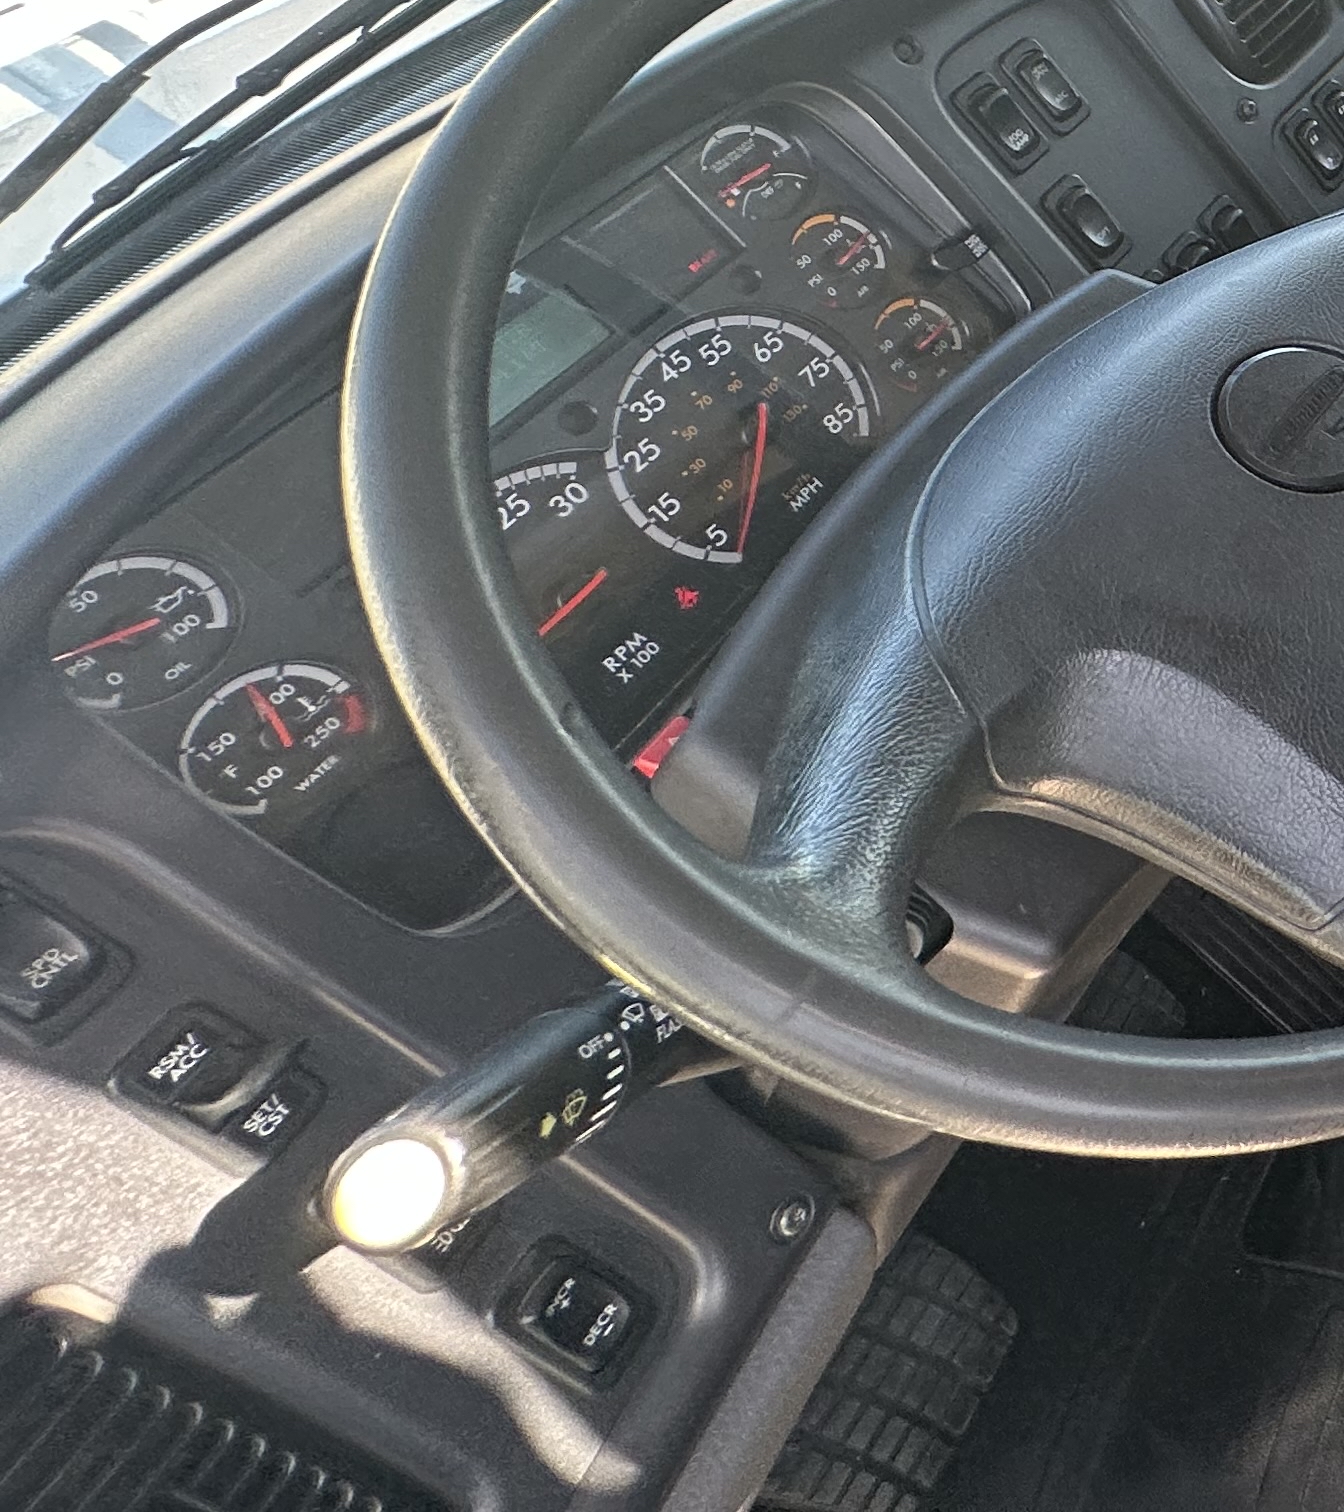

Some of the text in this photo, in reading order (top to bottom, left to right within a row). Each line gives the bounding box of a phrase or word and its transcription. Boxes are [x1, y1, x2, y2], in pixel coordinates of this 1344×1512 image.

[822, 228, 843, 246] 100
[796, 254, 811, 269] 50
[850, 257, 871, 275] 150
[827, 286, 838, 297] 0
[903, 312, 922, 329] 100
[698, 334, 732, 366] 55
[754, 331, 784, 363] 65
[879, 339, 894, 354] 50
[661, 349, 692, 382] 45
[797, 356, 830, 388] 75
[907, 370, 917, 380] 0
[727, 379, 743, 394] 90
[629, 389, 666, 423] 35
[694, 395, 713, 410] 70
[822, 402, 854, 434] 85
[681, 425, 698, 442] 50
[623, 438, 661, 473] 25
[688, 458, 707, 475] 30
[549, 482, 590, 518] 30
[717, 478, 734, 493] 10
[789, 476, 824, 512] MPH
[498, 493, 531, 531] 25
[648, 492, 681, 523] 15
[705, 524, 728, 547] 5
[68, 590, 98, 613] 50
[161, 614, 201, 643] 100
[64, 656, 97, 677] PSI
[602, 632, 648, 673] RPM
[629, 641, 660, 669] 100
[106, 672, 123, 686] 0
[164, 661, 193, 680] OIL
[195, 731, 236, 762] 150
[304, 717, 340, 748] 250
[245, 766, 283, 795] 100
[293, 755, 342, 792] WATER
[20, 948, 61, 978] SPD
[31, 952, 80, 989] CNTL
[148, 1032, 196, 1080] RSM/
[578, 1034, 605, 1059] OFF
[170, 1043, 209, 1083] ACC
[242, 1092, 282, 1134] SET/
[258, 1102, 291, 1137] CST
[582, 1303, 618, 1347] DECR
